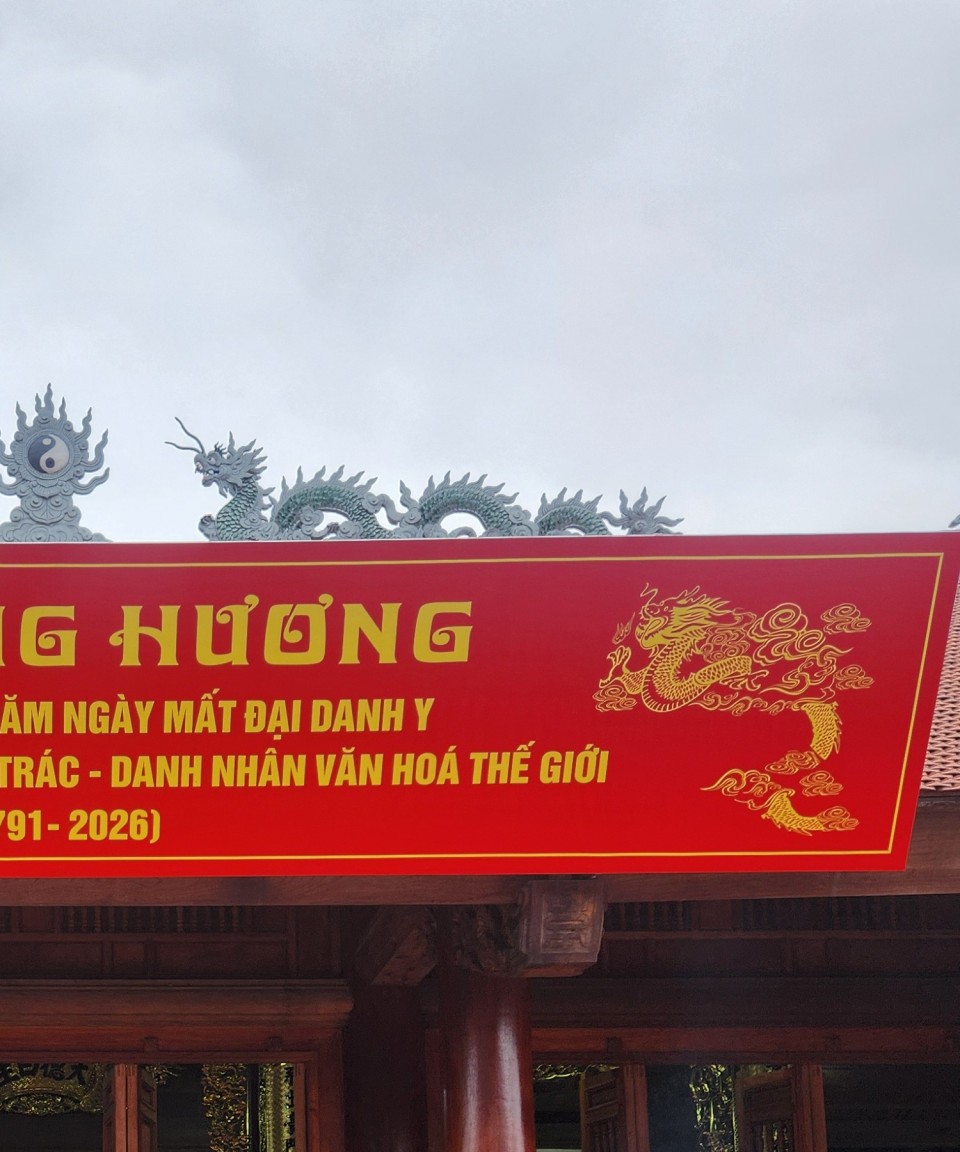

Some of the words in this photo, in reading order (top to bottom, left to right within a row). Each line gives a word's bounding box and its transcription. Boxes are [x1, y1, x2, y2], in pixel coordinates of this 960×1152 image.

[108, 593, 473, 667] HƯƠNG
[63, 693, 155, 735] NGÀY
[163, 687, 237, 734] MẤT
[243, 699, 302, 741] ĐẠI
[310, 698, 405, 733] DANH
[414, 697, 435, 731] Y
[89, 770, 102, 778] -
[110, 755, 203, 788] DANH
[211, 747, 307, 788] NHÂN
[315, 746, 384, 787] VĂN
[391, 745, 460, 786] HOÁ
[469, 740, 536, 785] THẾ
[539, 743, 610, 784] GIỚI
[68, 808, 161, 844] 2026)
